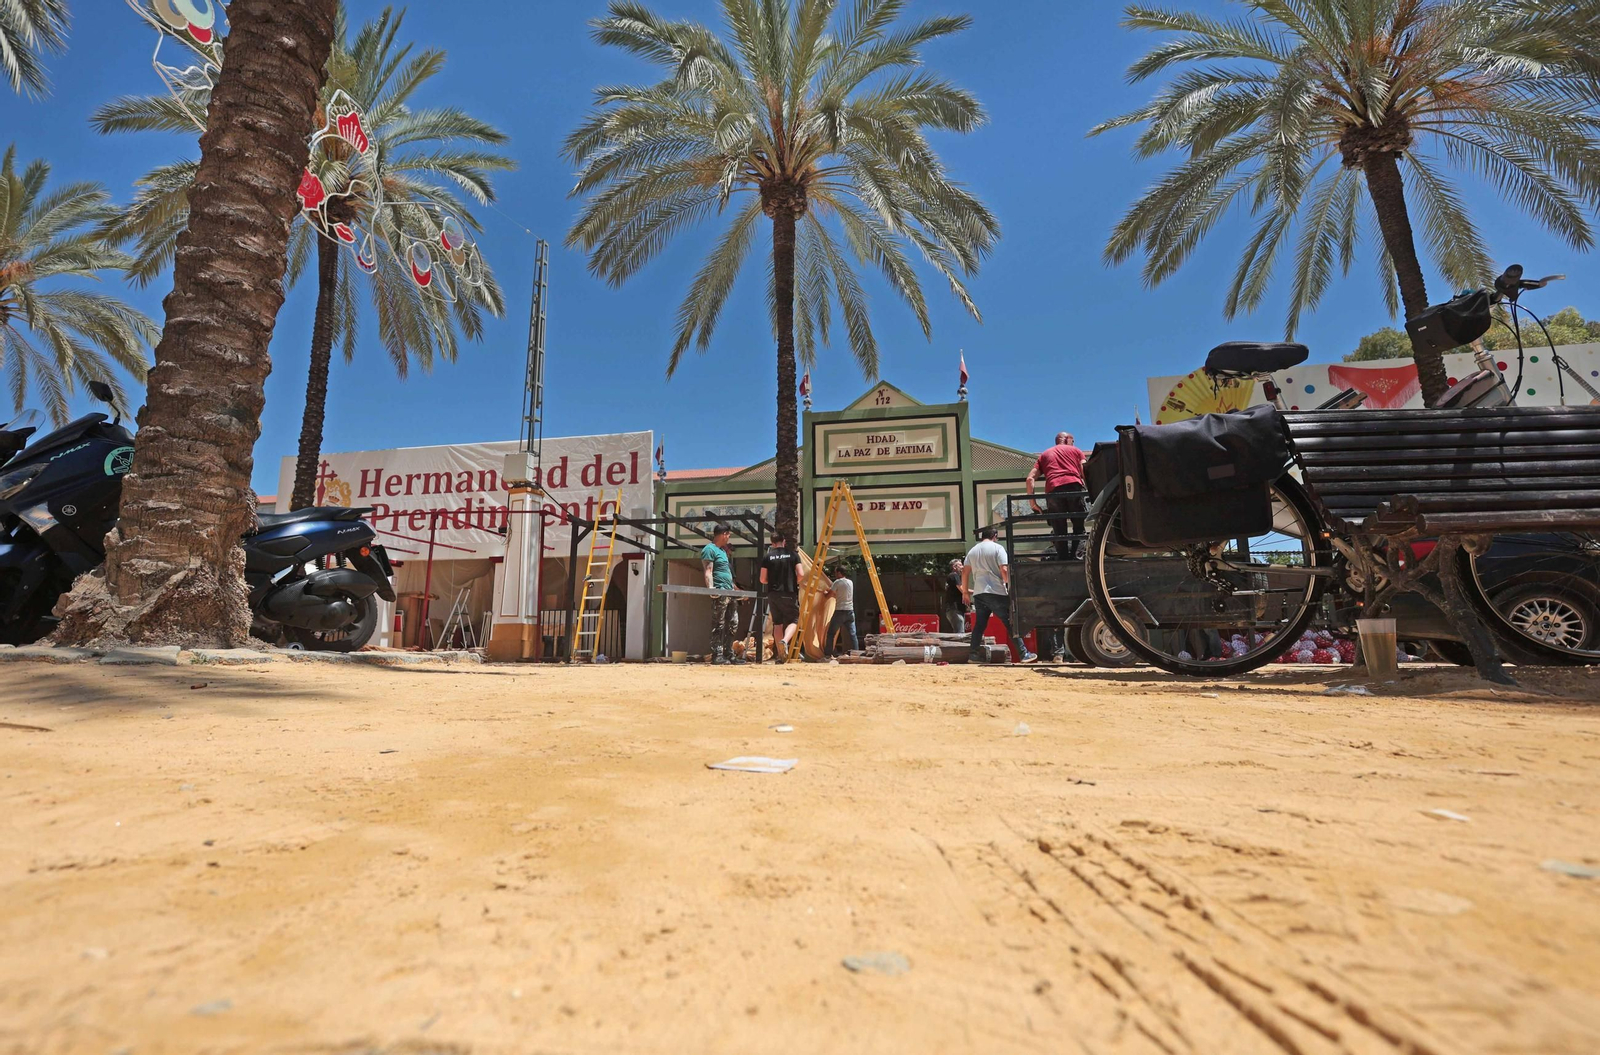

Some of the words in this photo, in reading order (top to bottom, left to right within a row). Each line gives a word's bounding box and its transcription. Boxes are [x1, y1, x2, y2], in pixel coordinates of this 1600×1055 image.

[875, 396, 891, 406] 172
[838, 449, 851, 458] LA
[854, 447, 871, 457] PAZ
[877, 447, 890, 456] DE
[895, 445, 933, 454] FATIMA
[357, 456, 569, 498] Hermanad
[580, 451, 639, 487] del
[869, 501, 886, 511] DE
[892, 500, 923, 511] MAYO
